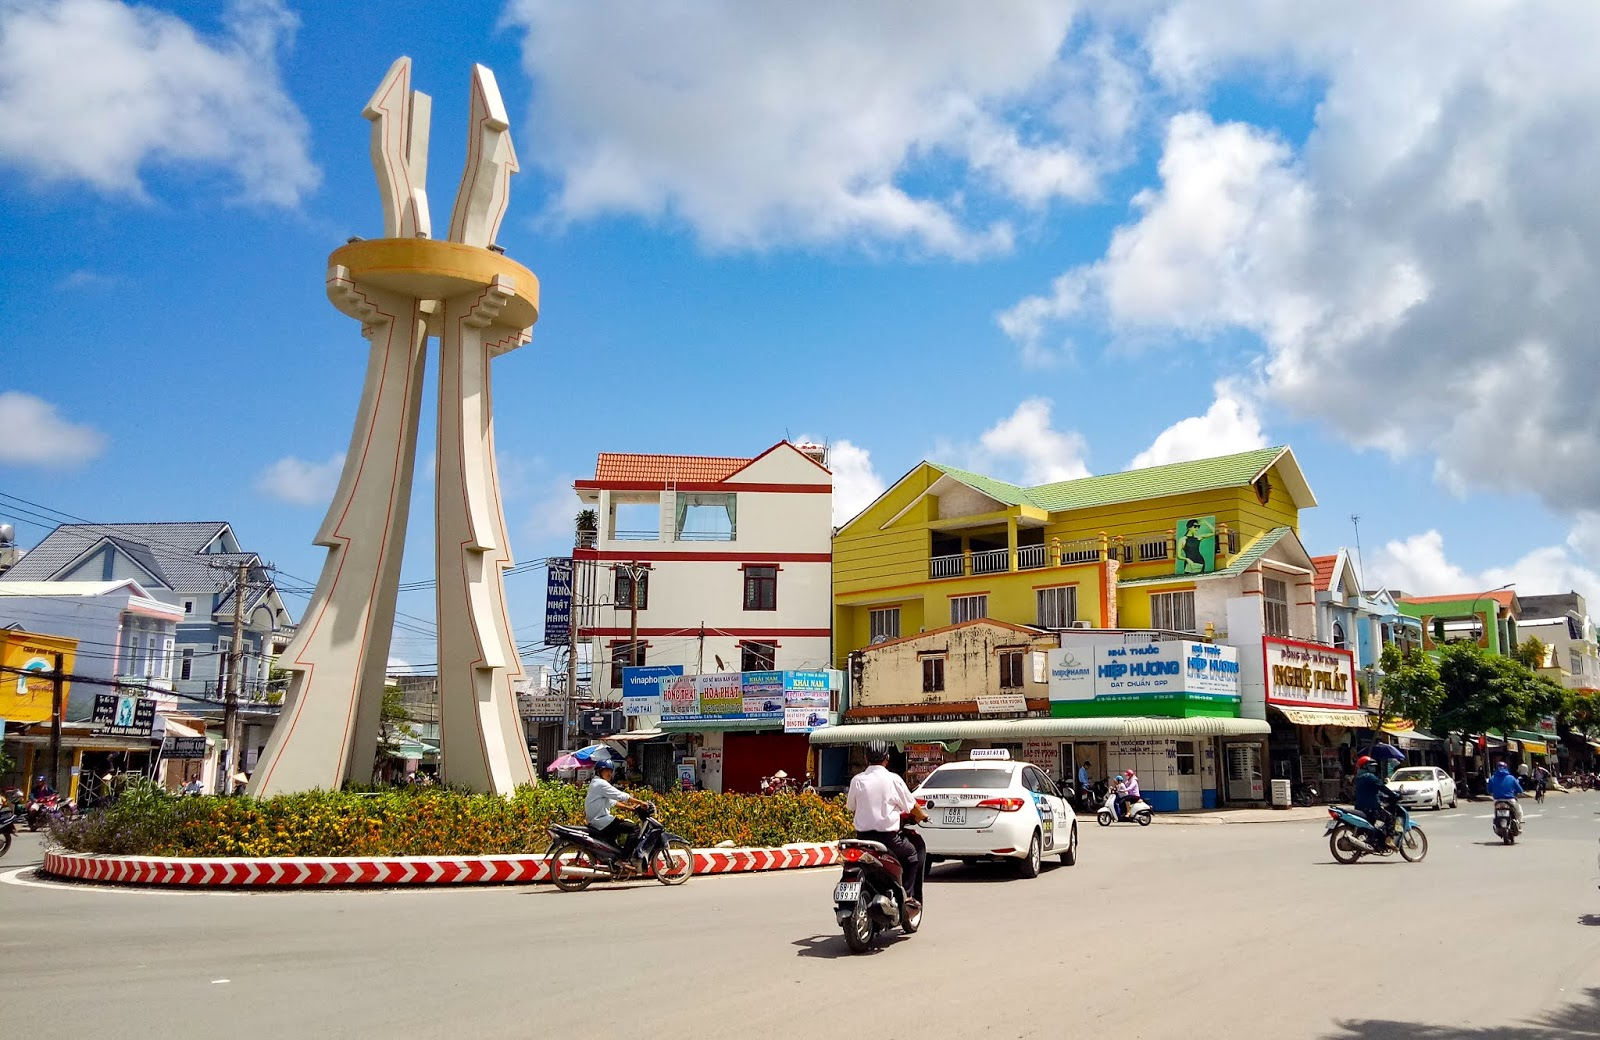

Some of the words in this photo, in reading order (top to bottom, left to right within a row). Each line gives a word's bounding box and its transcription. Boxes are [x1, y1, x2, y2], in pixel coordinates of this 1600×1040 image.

[1108, 646, 1127, 657] NHÀ
[1129, 643, 1160, 656] THUỐC
[1280, 645, 1301, 661] ĐỒNG
[1098, 660, 1128, 681] HIỆP
[1129, 660, 1180, 677] HƯƠNG
[1187, 653, 1208, 673] HIỆP
[1209, 658, 1240, 674] HƯƠNG
[1110, 680, 1124, 689] ĐẠT
[1313, 665, 1349, 692] PHÁT
